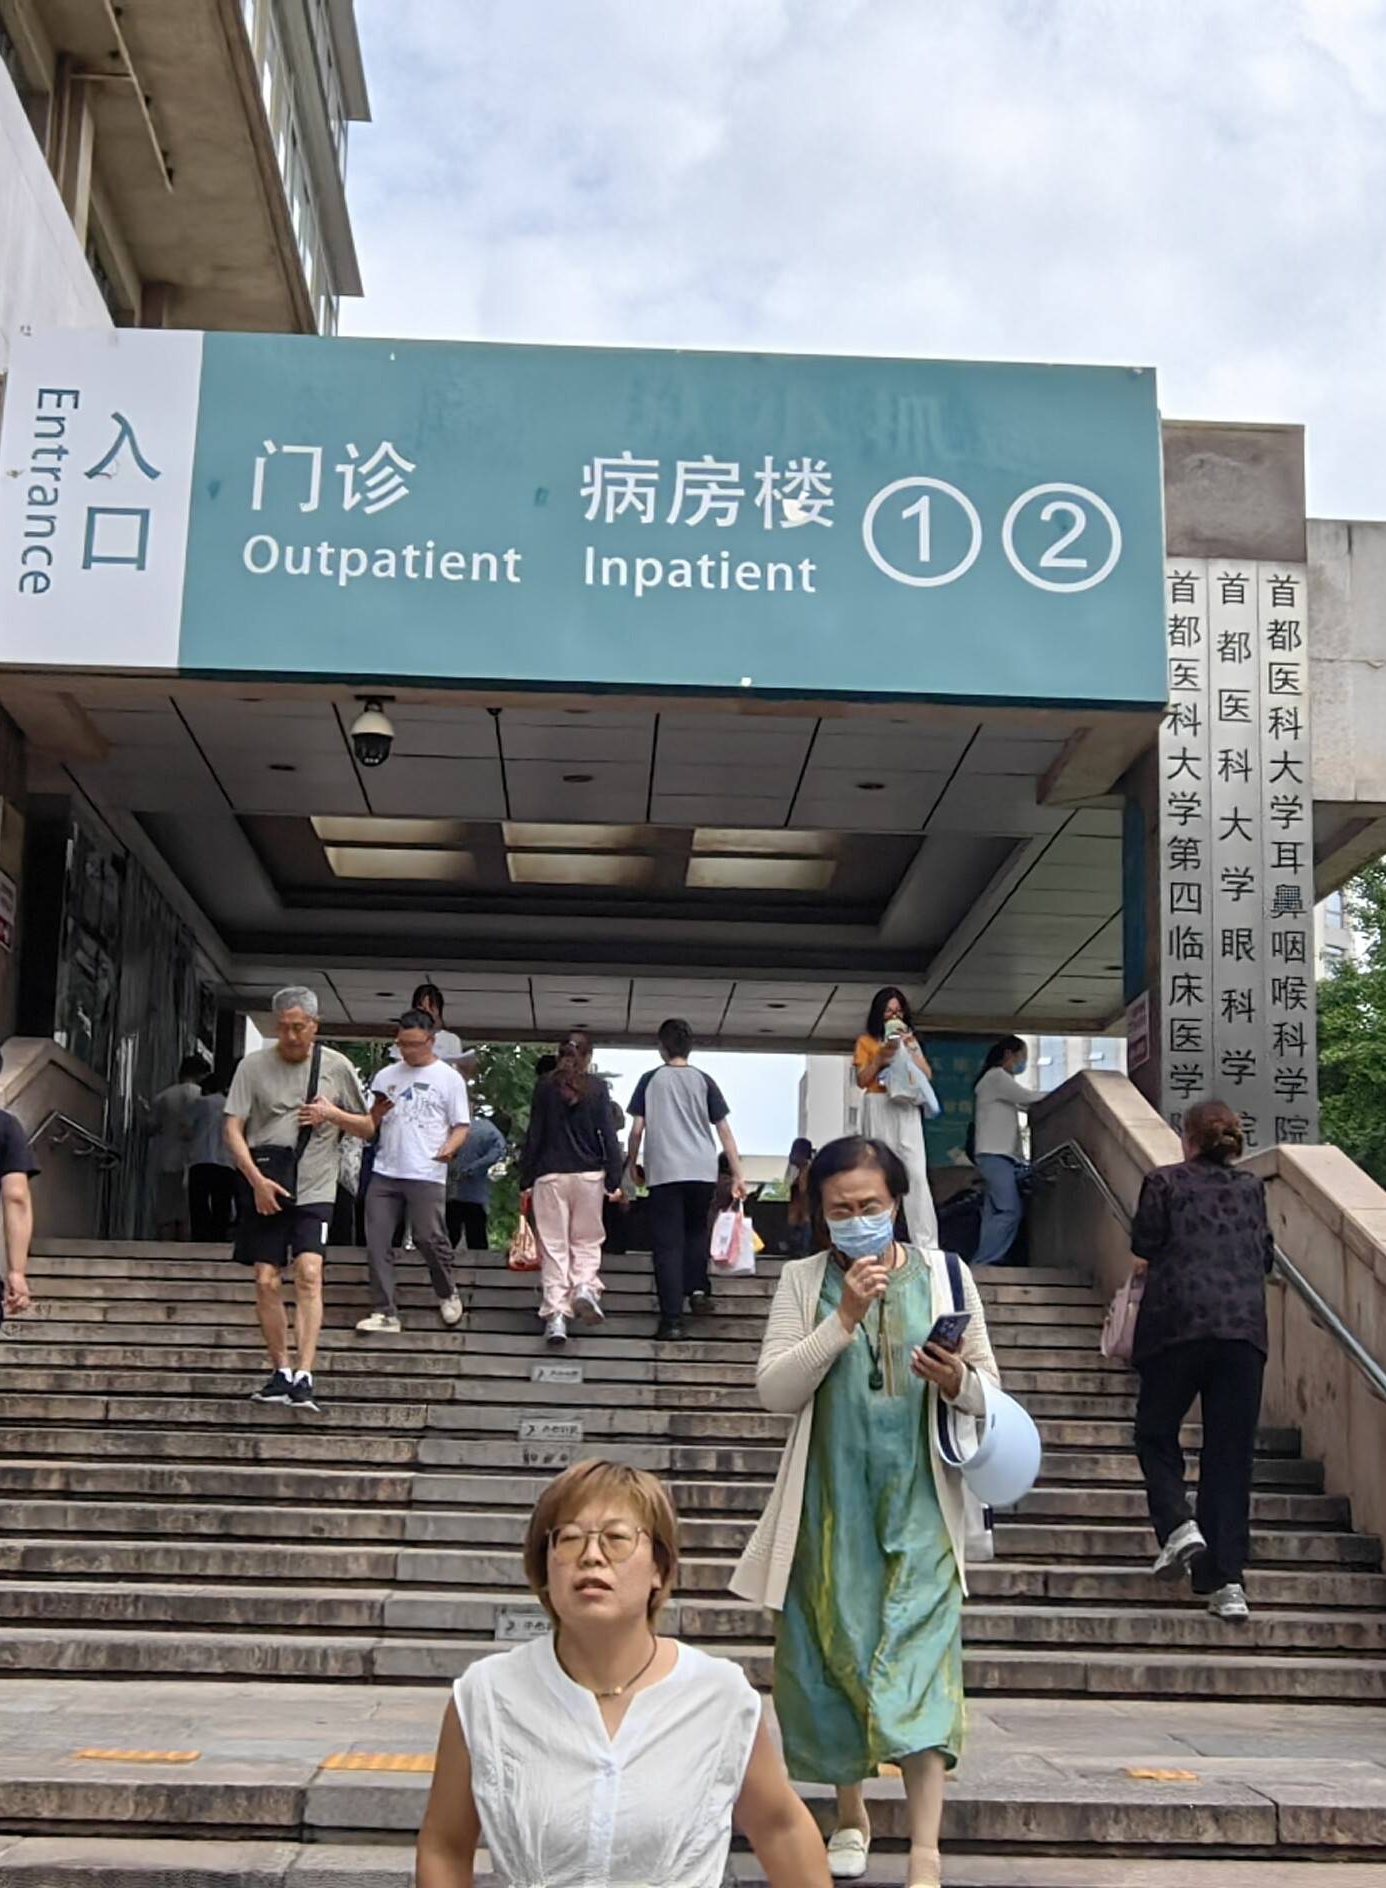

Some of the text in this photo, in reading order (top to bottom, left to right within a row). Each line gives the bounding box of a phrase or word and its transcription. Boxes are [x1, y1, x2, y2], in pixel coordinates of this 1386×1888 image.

[18, 387, 80, 595] Entrance
[82, 411, 161, 572] 入口
[250, 440, 416, 515] 门诊
[580, 451, 834, 529] 病房楼
[243, 535, 522, 586] Outpatient
[585, 547, 816, 597] Inpatient
[1165, 569, 1205, 1134] 首都医科大学第四临床医学
